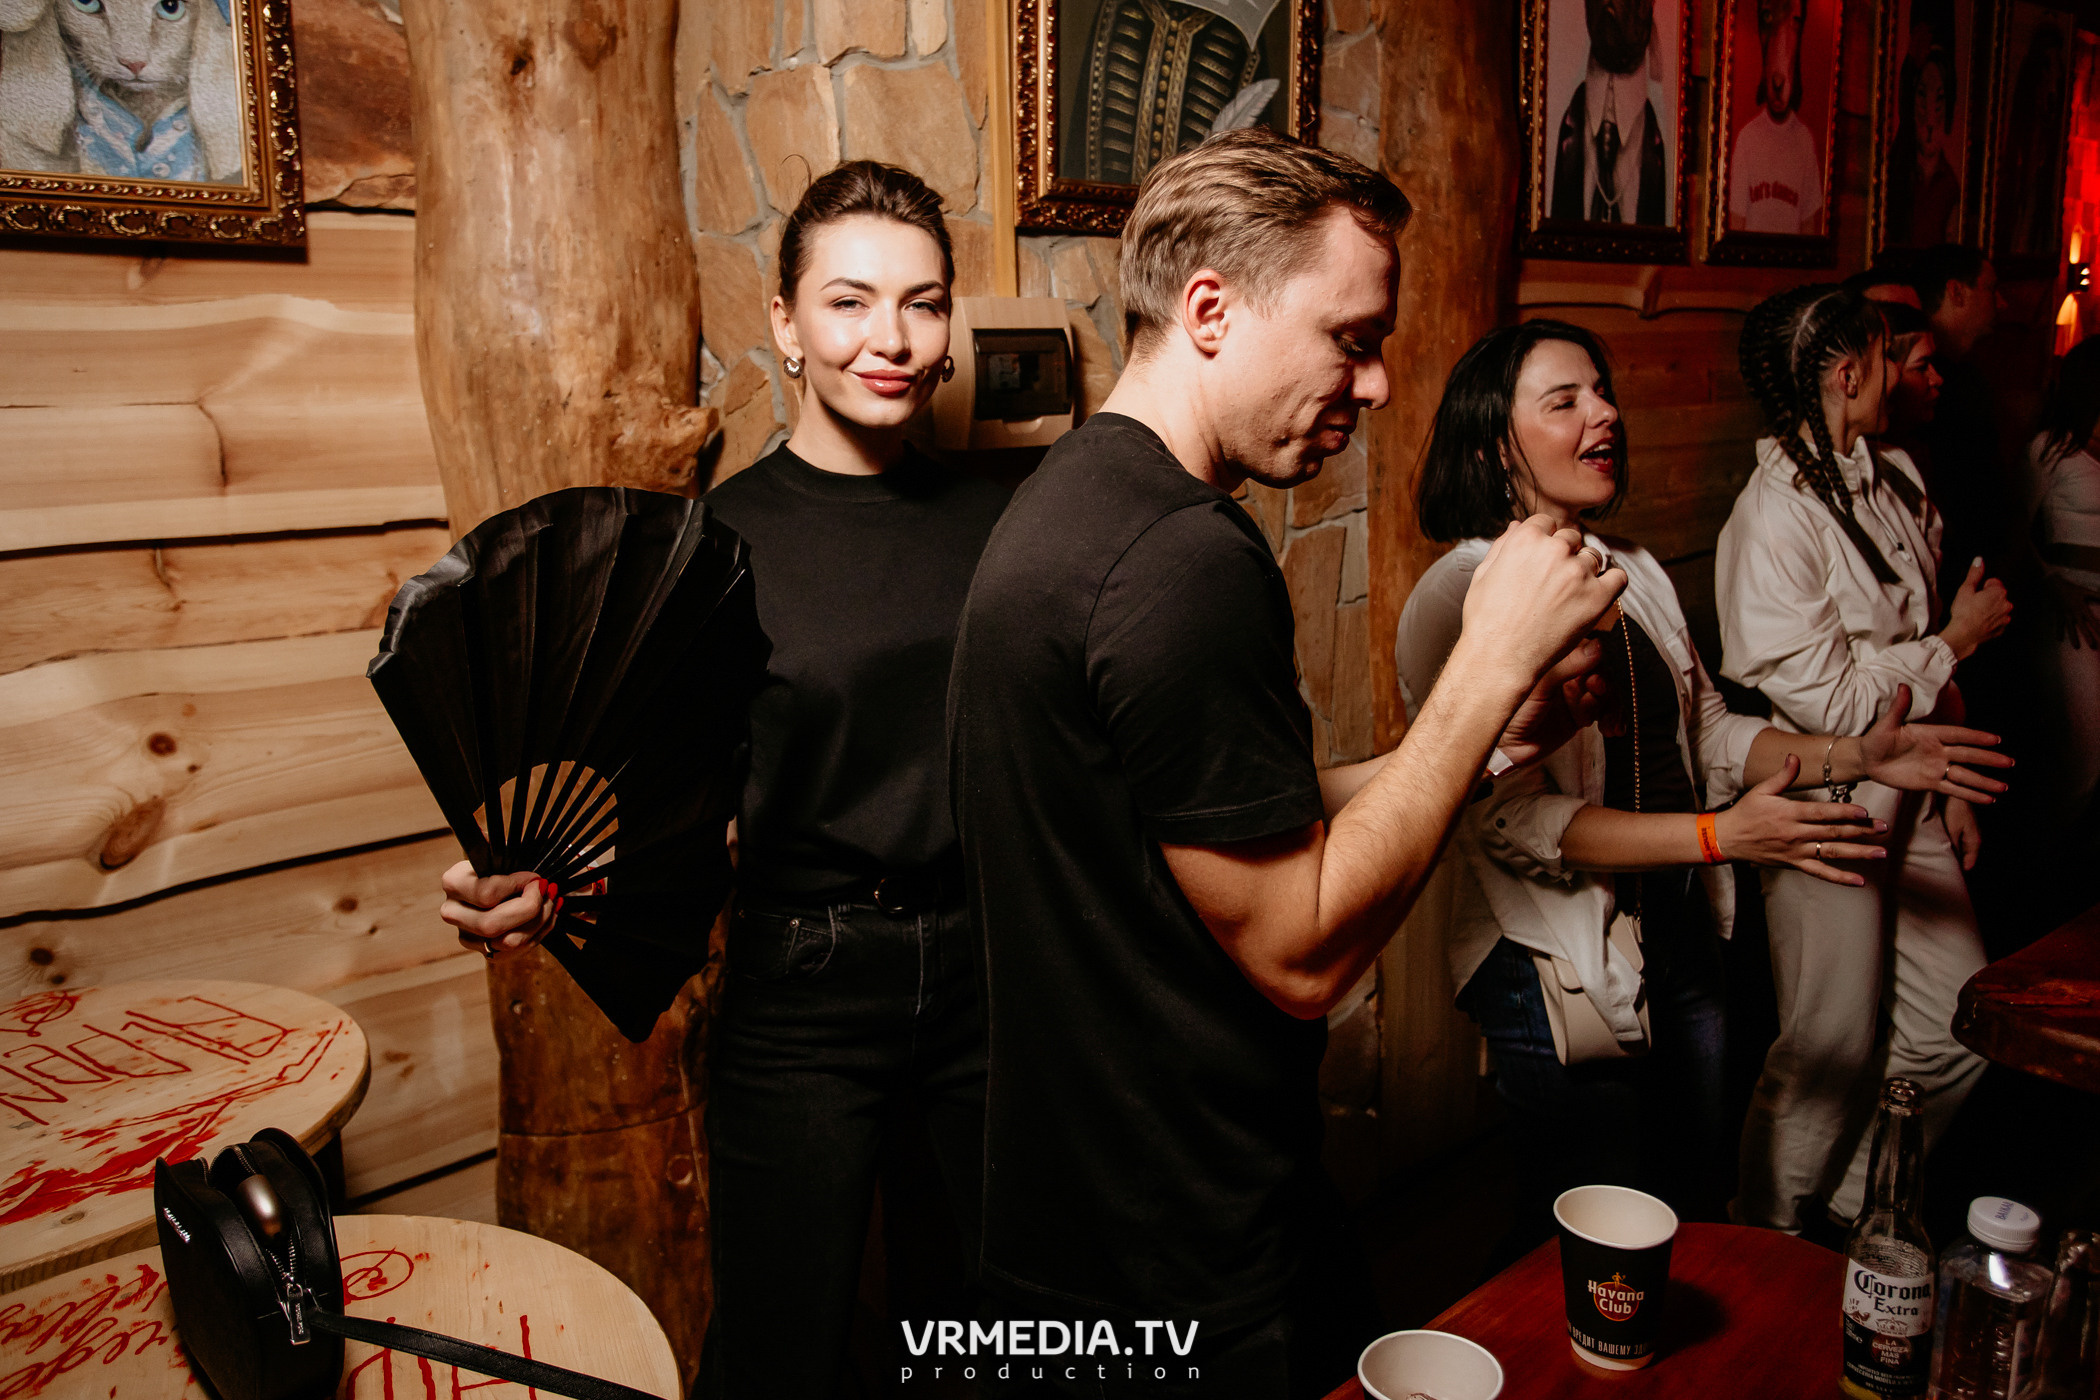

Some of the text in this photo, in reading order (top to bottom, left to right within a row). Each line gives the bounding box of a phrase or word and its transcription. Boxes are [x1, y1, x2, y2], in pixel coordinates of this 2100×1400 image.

[1587, 1280, 1645, 1301] Havana
[1853, 1269, 1931, 1299] Corona
[1599, 1298, 1632, 1314] Club
[1873, 1297, 1919, 1316] Extra
[1598, 1340, 1632, 1356] ВАШЕМУ
[1885, 1339, 1897, 1347] LA
